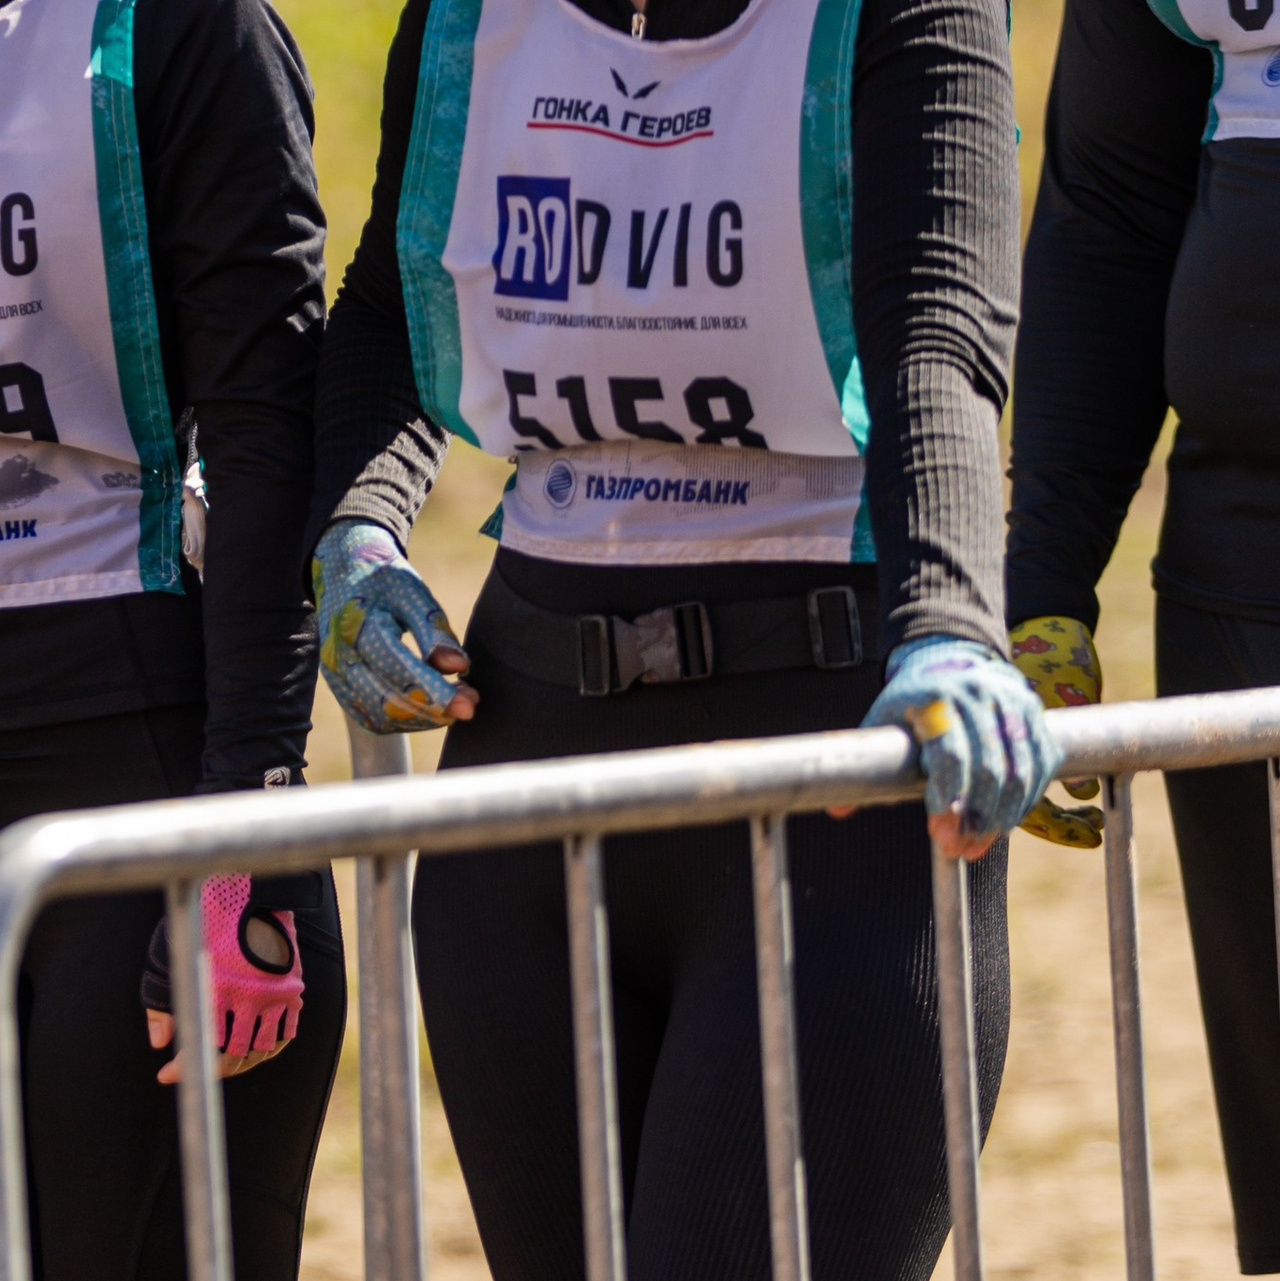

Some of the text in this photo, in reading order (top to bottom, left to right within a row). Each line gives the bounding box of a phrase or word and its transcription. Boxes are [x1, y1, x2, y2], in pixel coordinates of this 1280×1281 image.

[532, 97, 712, 138] ГОНКА ГЕРОЕВ
[500, 194, 744, 290] RODVIG
[0, 305, 19, 319] ДЛЯ
[20, 300, 44, 316] ВСЕХ
[700, 316, 721, 331] ДЛЯ
[722, 315, 748, 331] ВСЕХ
[585, 475, 749, 505] ГАЗПРОМБАНК
